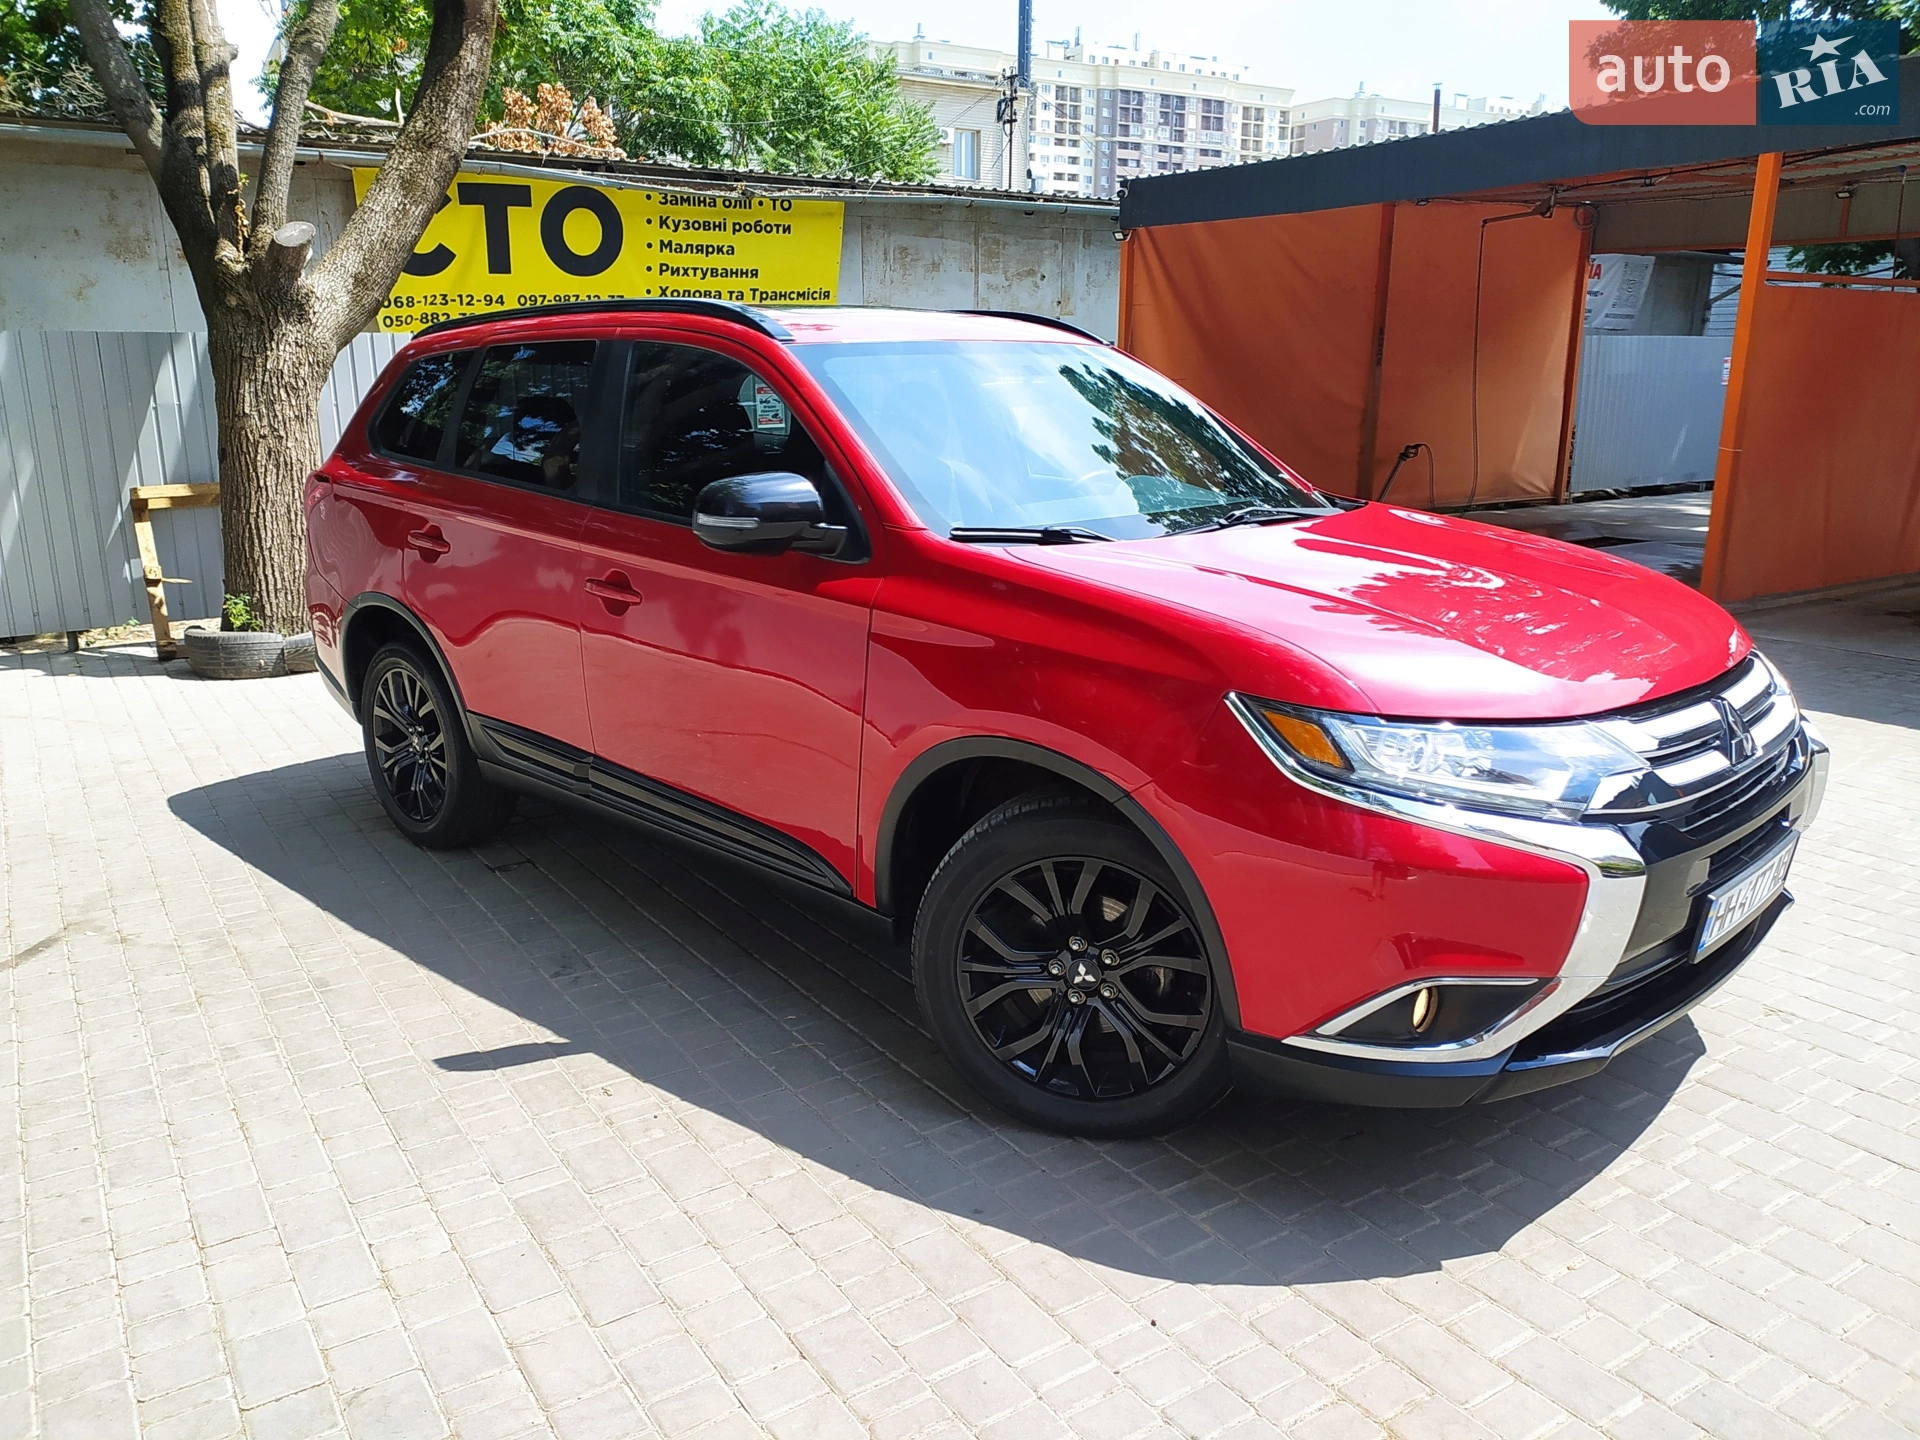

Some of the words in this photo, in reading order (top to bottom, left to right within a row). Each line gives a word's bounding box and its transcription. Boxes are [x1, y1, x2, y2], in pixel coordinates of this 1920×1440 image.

[658, 193, 717, 208] Заміна
[769, 198, 793, 212] ТО
[658, 215, 727, 233] Кузовні
[732, 219, 792, 236] роботи
[659, 239, 735, 258] Малярка
[658, 263, 759, 280] Рихтування
[658, 286, 722, 299] Ходова
[727, 290, 745, 301] та
[749, 287, 831, 303] Трансмісія
